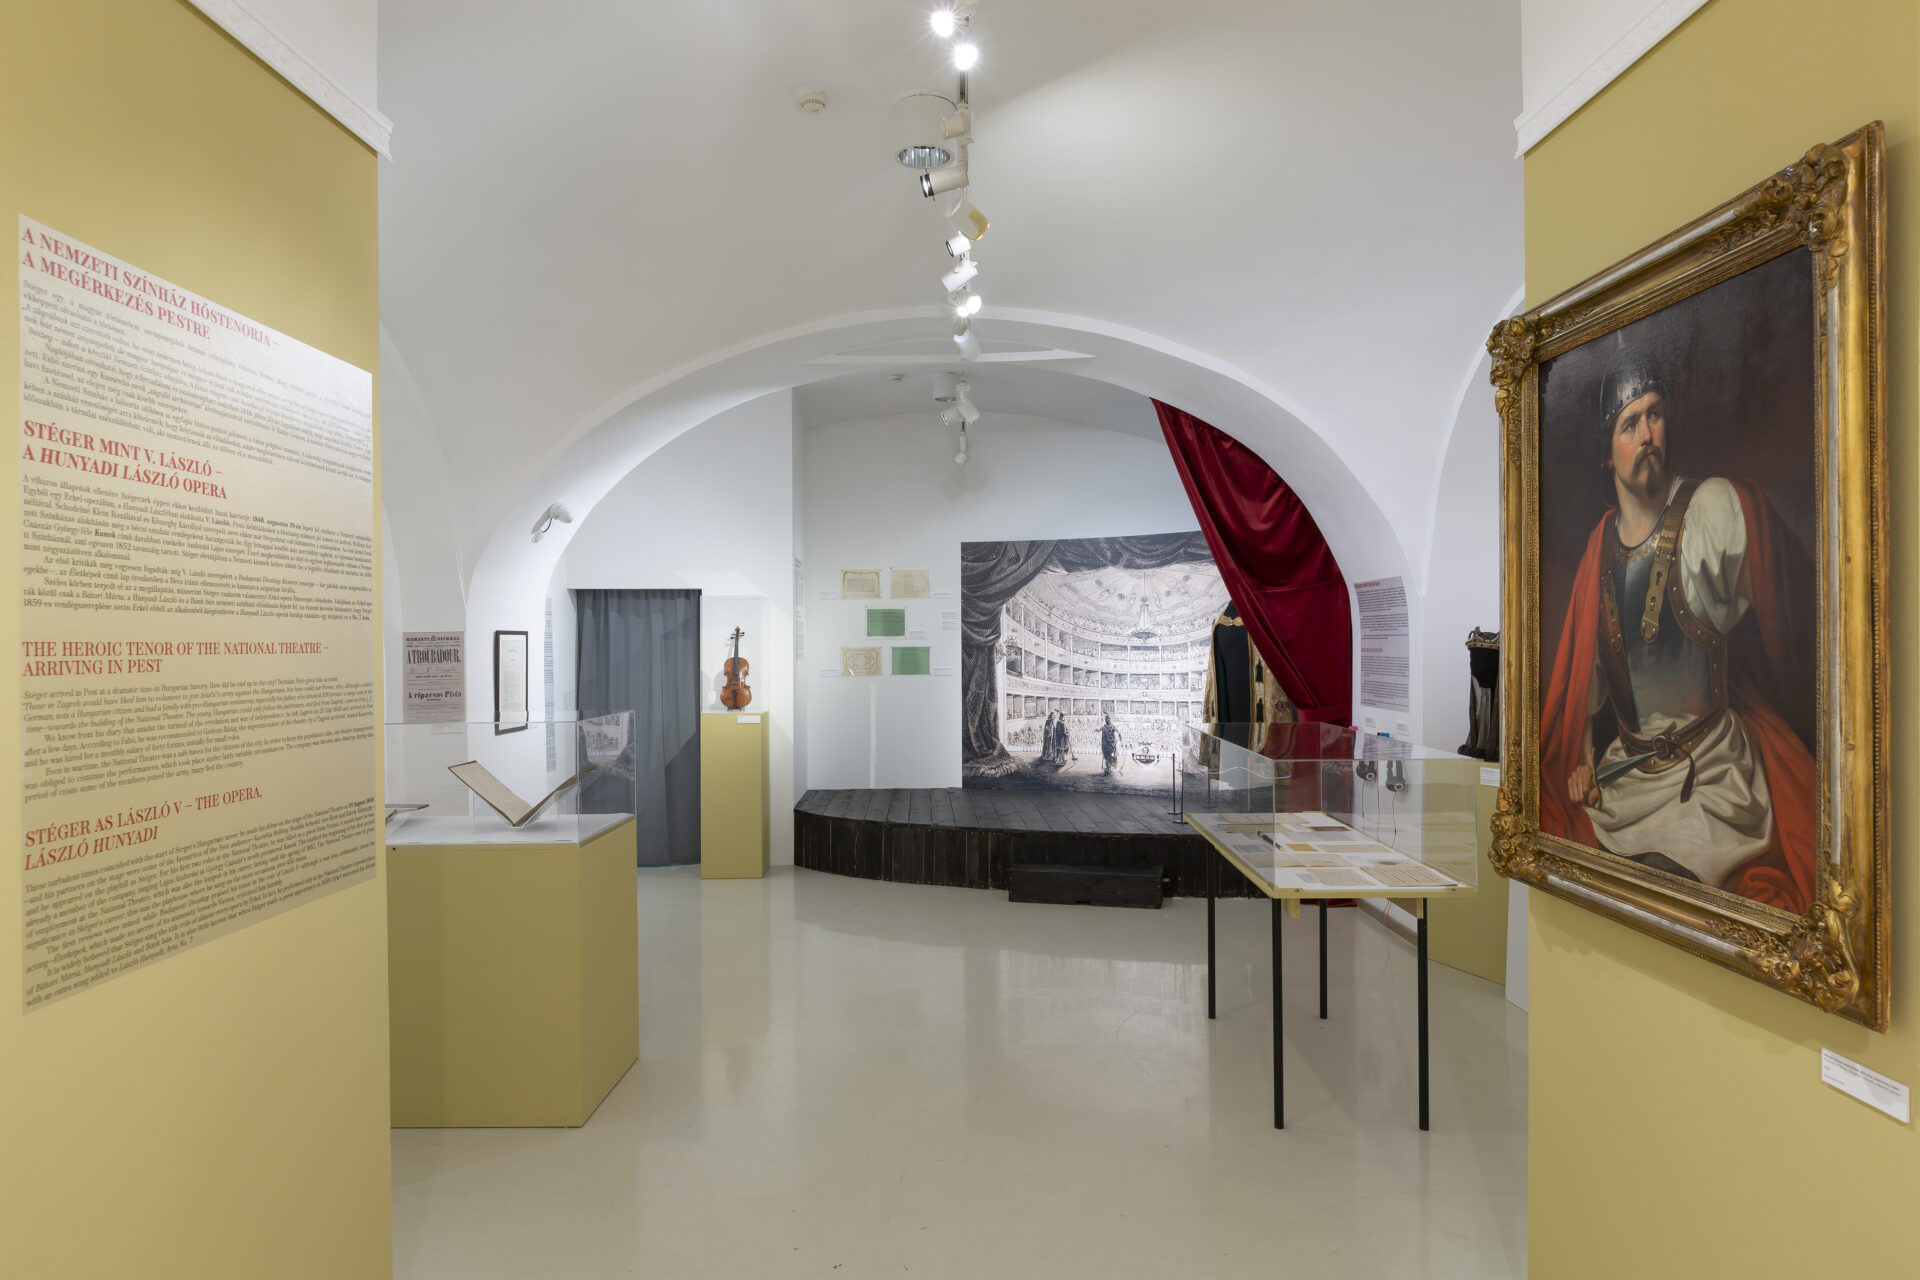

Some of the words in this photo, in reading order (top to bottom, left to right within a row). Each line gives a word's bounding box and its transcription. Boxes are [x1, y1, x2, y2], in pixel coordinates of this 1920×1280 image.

[22, 228, 34, 245] A
[40, 233, 118, 281] NEMZETI
[123, 271, 186, 310] SZÍNHÁZ
[191, 300, 270, 346] HŐSTENORJA
[22, 251, 35, 268] A
[40, 256, 153, 316] MEGÉRKEZÉS
[158, 306, 210, 339] PESTRE
[22, 445, 34, 461] A
[40, 447, 118, 477] HUNYADI
[123, 464, 179, 489] LÁSZLÓ
[183, 478, 227, 499] OPERA
[24, 420, 95, 451] STÉGER
[100, 438, 140, 460] MINT
[145, 448, 155, 464] V.
[160, 451, 212, 476] LÁSZLÓ
[22, 641, 56, 657] THE
[62, 642, 122, 656] HEROIC
[127, 642, 173, 656] TENOR
[177, 642, 193, 655] OF
[197, 642, 220, 655] THE
[224, 642, 277, 655] NATIONAL
[280, 642, 321, 654] THEATRE
[23, 660, 103, 676] ARRIVING
[108, 660, 123, 674] IN
[128, 659, 162, 673] PEST
[444, 690, 462, 698] Pista
[25, 820, 91, 847] STÉGER
[95, 816, 113, 832] AS
[117, 800, 170, 828] LÁSZLÓ
[174, 801, 182, 814] V
[195, 794, 219, 810] THE
[223, 786, 262, 804] OPERA,
[25, 838, 89, 871] LÁSZLÓ
[93, 826, 158, 854] HUNYADI
